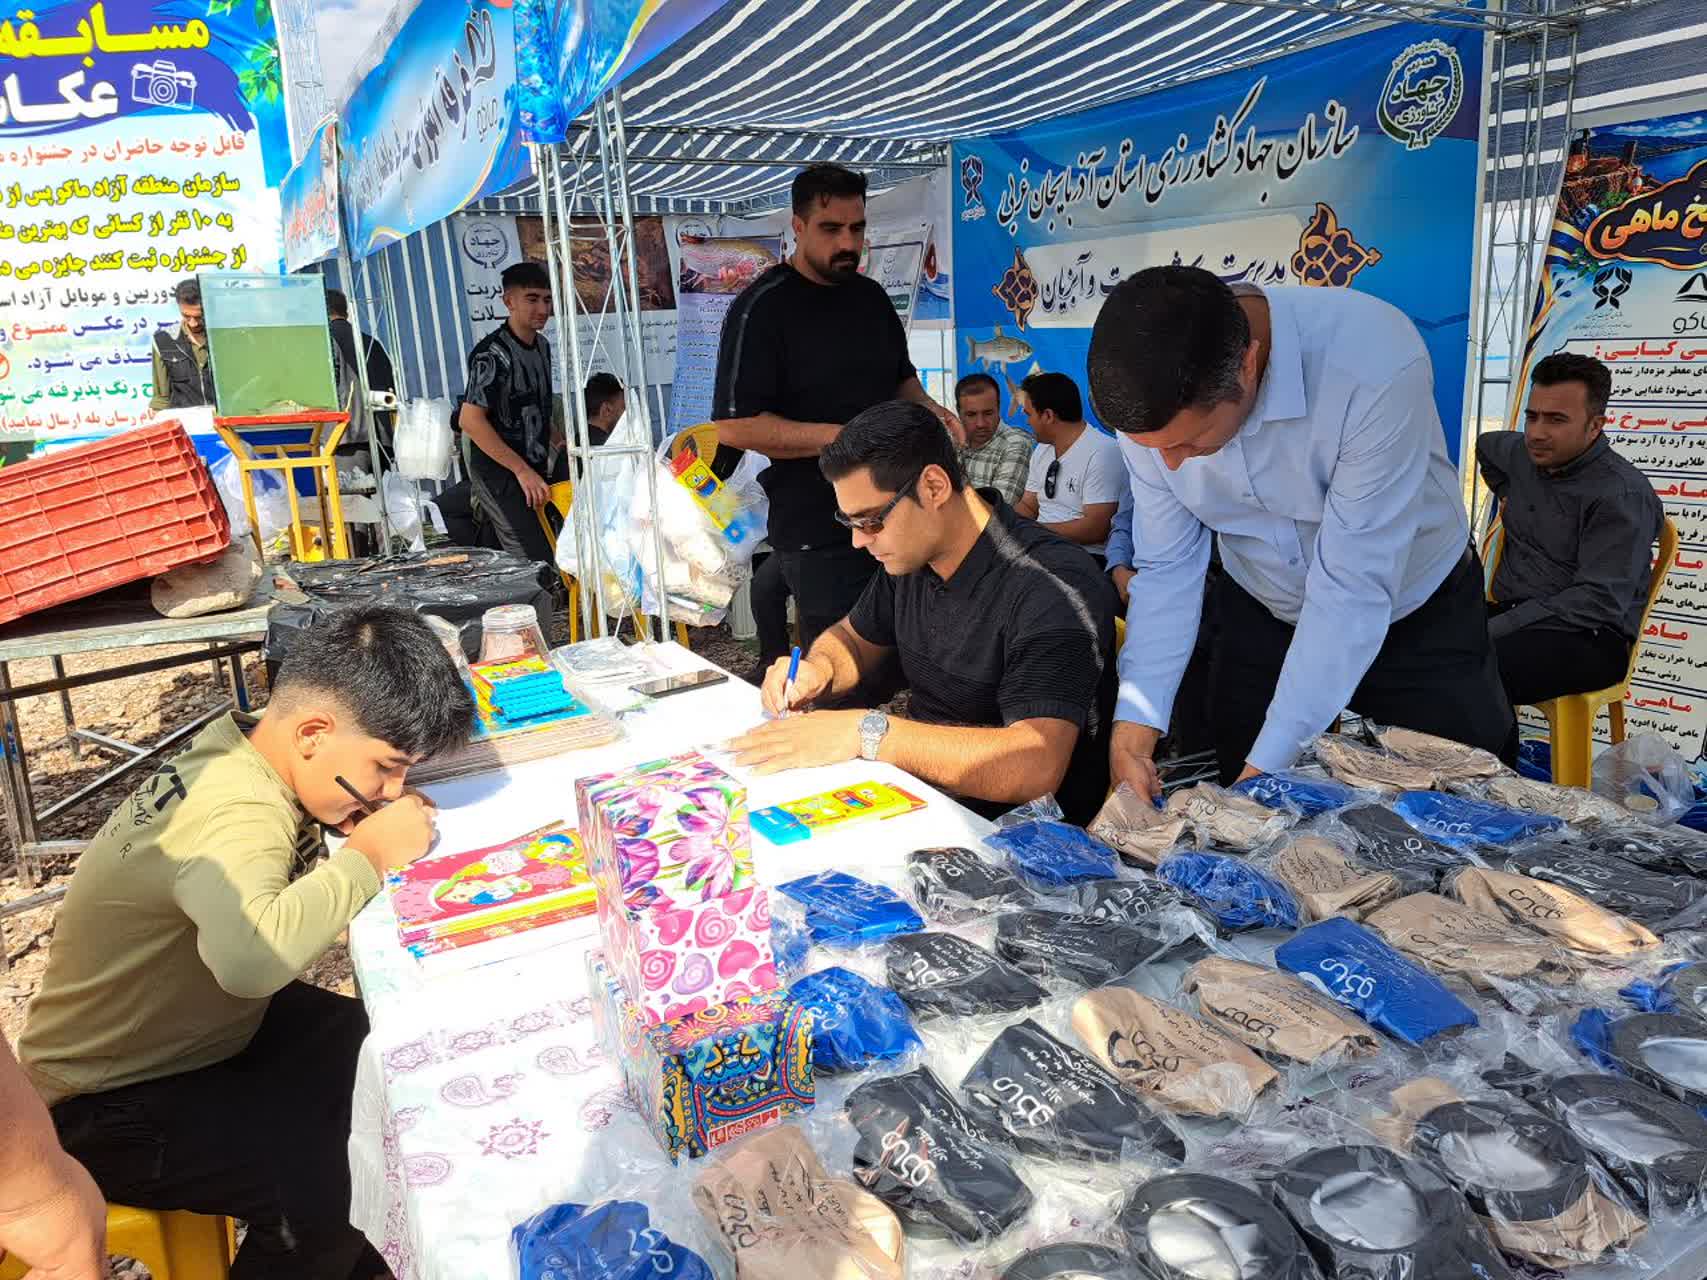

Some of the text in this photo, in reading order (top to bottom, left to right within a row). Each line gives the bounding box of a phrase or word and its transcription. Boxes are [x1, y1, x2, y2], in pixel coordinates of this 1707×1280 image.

[1391, 77, 1449, 102] جهاد
[1397, 94, 1445, 125] کشاورزی
[10, 134, 245, 167] قابل توجه حاضران در جشنواره
[997, 76, 1359, 235] سازمان جهاد کشاورزی استان آذربایجان غربی
[6, 182, 22, 208] از
[56, 178, 90, 205] ماکو
[93, 175, 128, 202] آزاد
[132, 175, 180, 196] منطقه
[183, 172, 240, 198] سازمان
[17, 221, 68, 243] بهترین
[70, 216, 90, 235] که
[94, 212, 144, 239] کسانی
[148, 211, 164, 237] از
[168, 210, 191, 236] نفر
[215, 212, 234, 231] به
[1600, 200, 1679, 250] ماهی
[42, 253, 87, 279] جایزه
[89, 250, 124, 271] کنند
[127, 247, 158, 272] ثبت
[160, 246, 227, 272] جشنواره
[231, 244, 248, 270] از
[15, 261, 40, 280] می
[1040, 250, 1092, 314] آبزیان
[1086, 274, 1097, 298] و
[21, 287, 52, 310] آزاد
[60, 287, 107, 309] موبایل
[113, 291, 121, 307] و
[11, 320, 69, 341] ممنوع
[73, 314, 125, 337] عکس
[131, 316, 148, 335] در
[1604, 341, 1678, 360] کبابی
[80, 356, 103, 372] می
[1614, 366, 1633, 375] شده
[1667, 365, 1692, 378] معطر
[21, 389, 43, 405] می
[47, 380, 100, 403] پذیرفته
[46, 411, 81, 430] ارسال
[1619, 411, 1668, 430] سرخ
[1641, 435, 1657, 448] آرد
[1668, 436, 1687, 448] آرد
[1650, 456, 1667, 468] ترد
[1675, 456, 1705, 469] طلایی
[1682, 507, 1689, 518] با
[1675, 581, 1697, 591] ماهی
[1658, 653, 1685, 664] حرارت
[1657, 671, 1681, 682] روشی
[1634, 695, 1692, 713] ماهی
[1658, 723, 1679, 733] کامل
[1679, 726, 1699, 738] ماهی
[992, 1077, 1056, 1126] ماکو
[881, 1130, 936, 1186] ماکو
